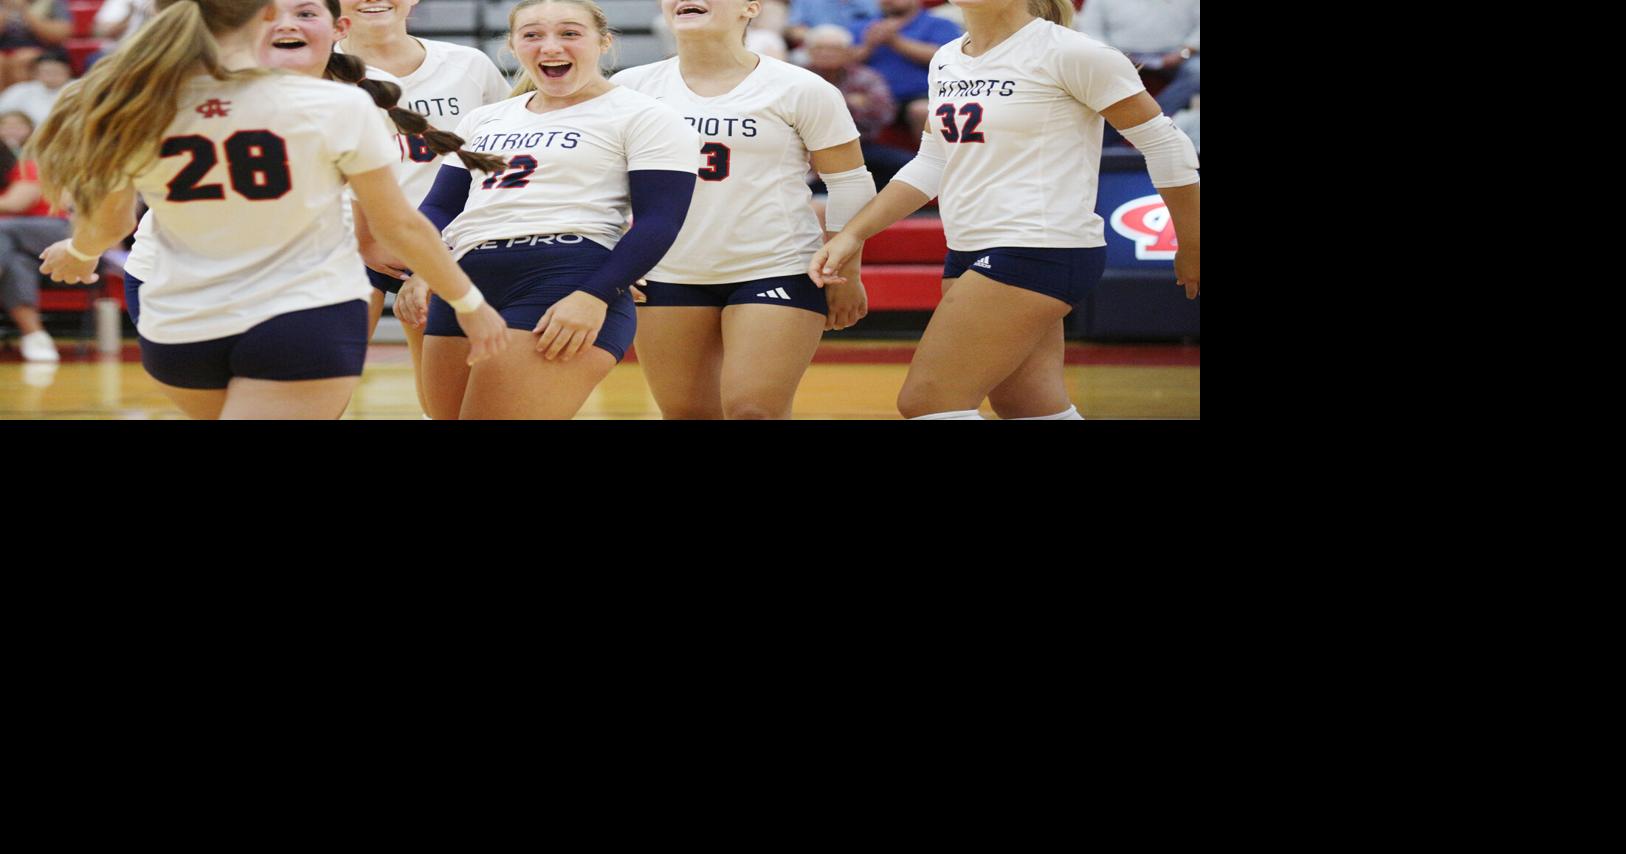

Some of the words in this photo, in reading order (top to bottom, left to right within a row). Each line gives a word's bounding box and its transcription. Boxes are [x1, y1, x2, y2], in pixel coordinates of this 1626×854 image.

[937, 79, 1016, 97] ATRIOTS
[935, 102, 985, 144] 32
[159, 129, 293, 203] 28
[396, 132, 438, 164] 6
[698, 142, 731, 182] 3
[505, 233, 584, 248] PRO
